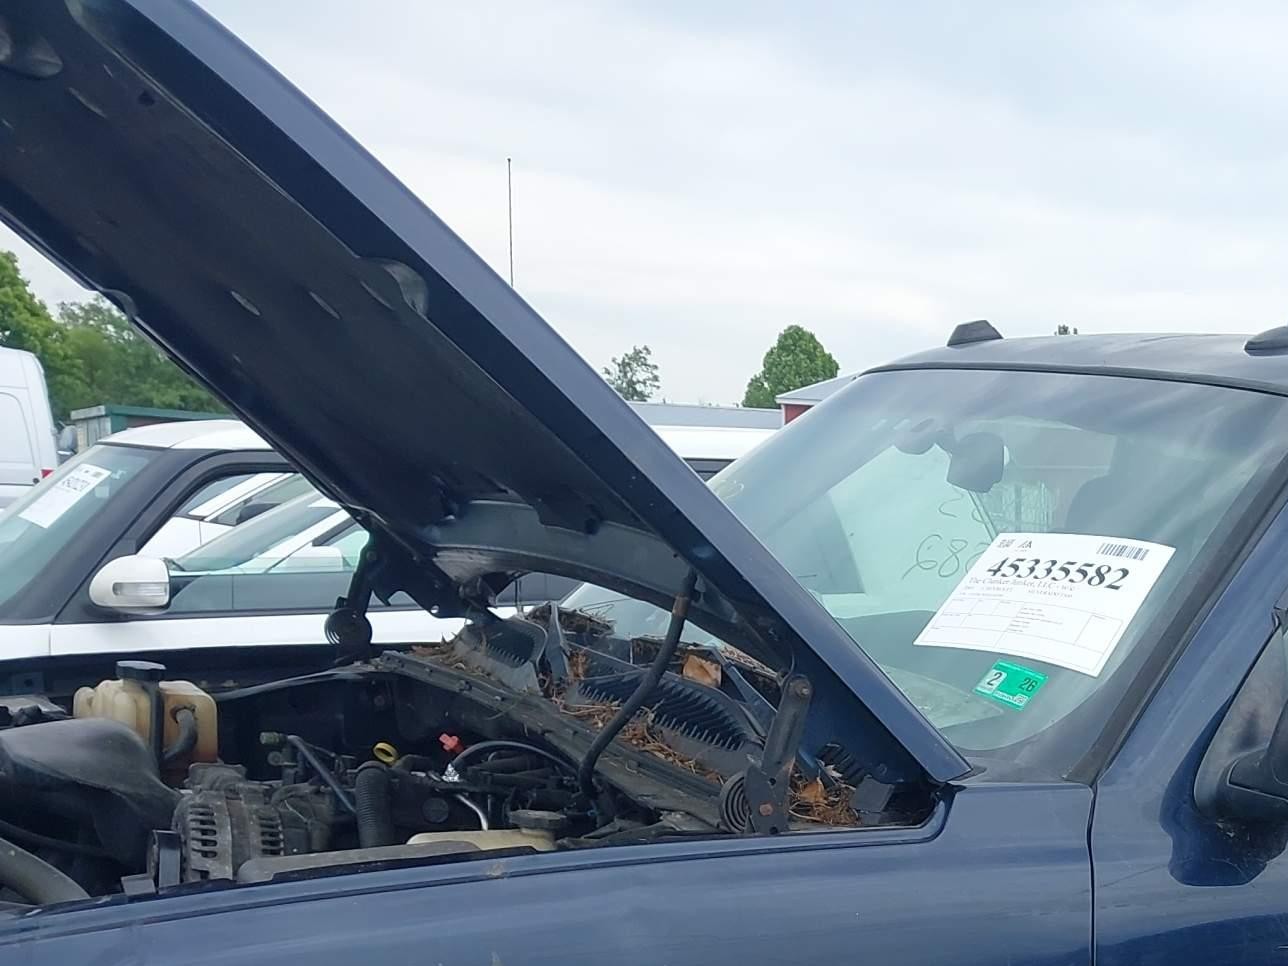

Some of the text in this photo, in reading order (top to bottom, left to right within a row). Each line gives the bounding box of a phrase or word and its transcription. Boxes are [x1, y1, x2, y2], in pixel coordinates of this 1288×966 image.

[986, 557, 1130, 591] 45335582
[986, 672, 1039, 692] 2 26
